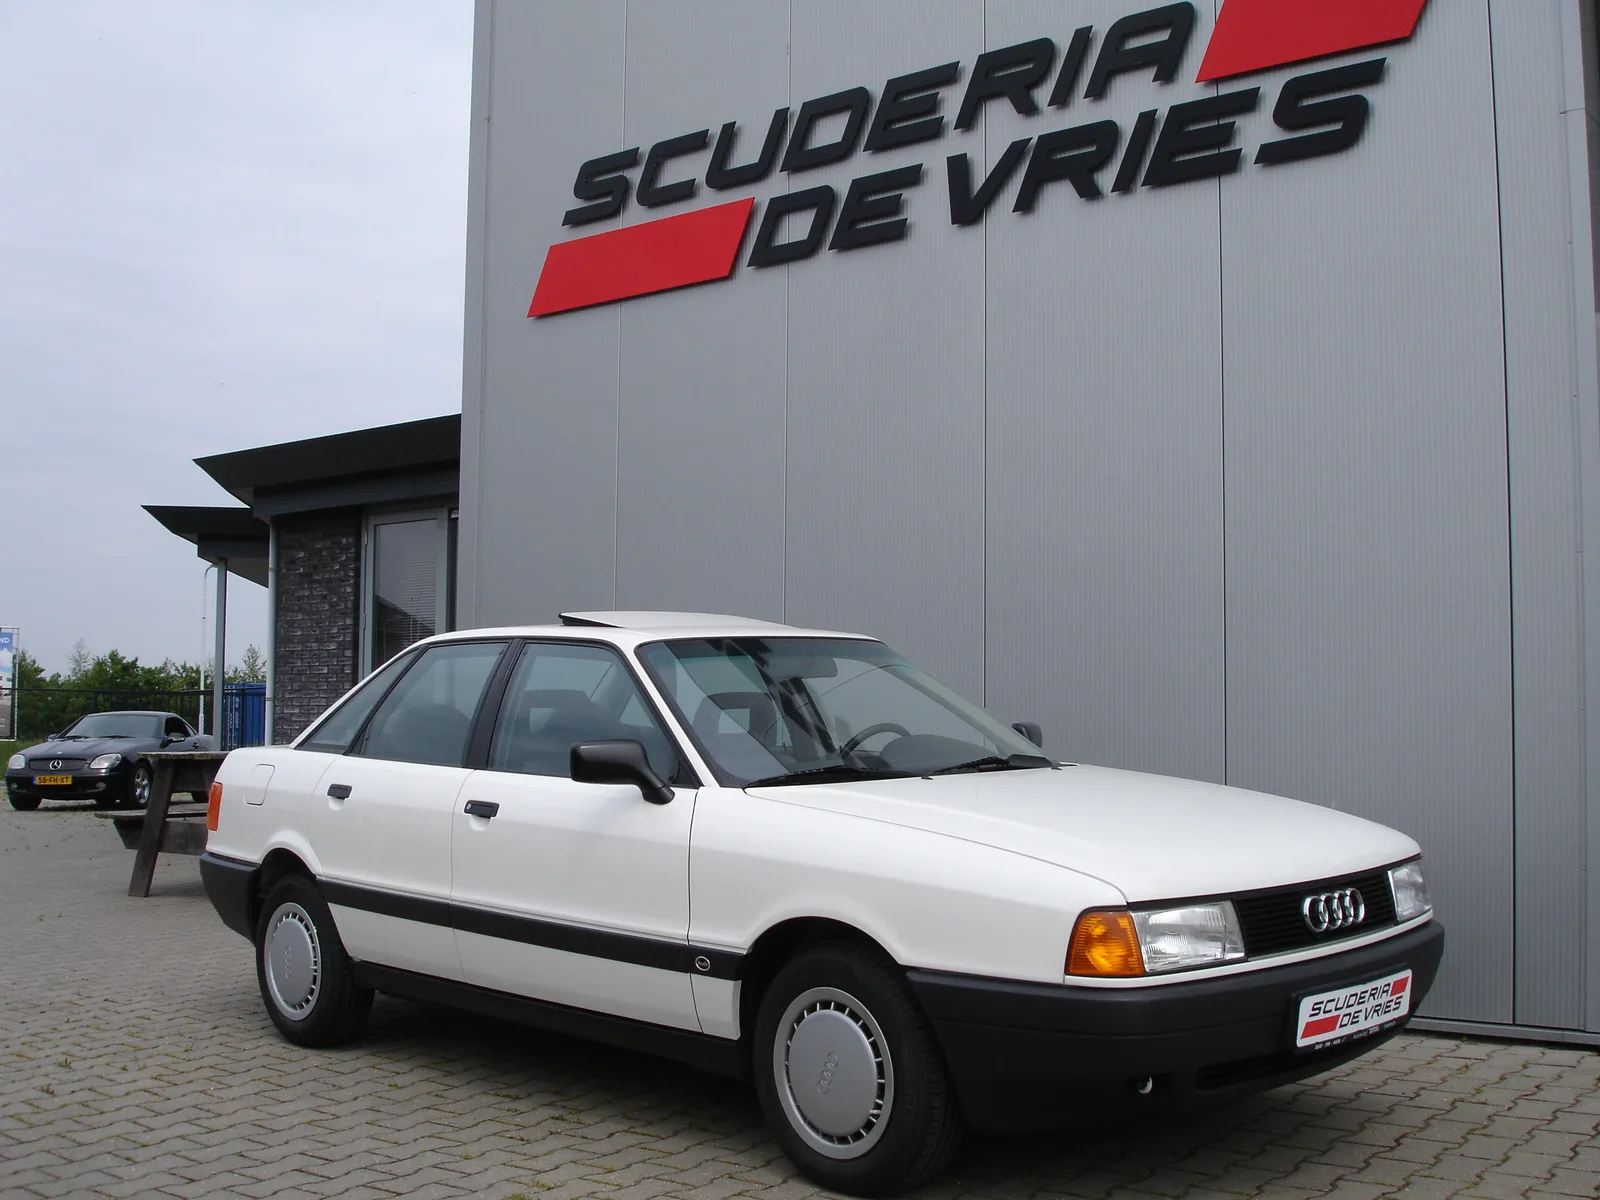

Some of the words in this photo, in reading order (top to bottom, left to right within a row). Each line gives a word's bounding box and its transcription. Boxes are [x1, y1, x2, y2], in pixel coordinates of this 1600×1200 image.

[562, 1, 1195, 226] SCUDERIA
[747, 163, 923, 268] DE
[946, 57, 1387, 225] VRIES
[1309, 982, 1391, 1017] SCUDERIA
[1338, 1009, 1362, 1029] DE
[1364, 995, 1403, 1021] VRIES
